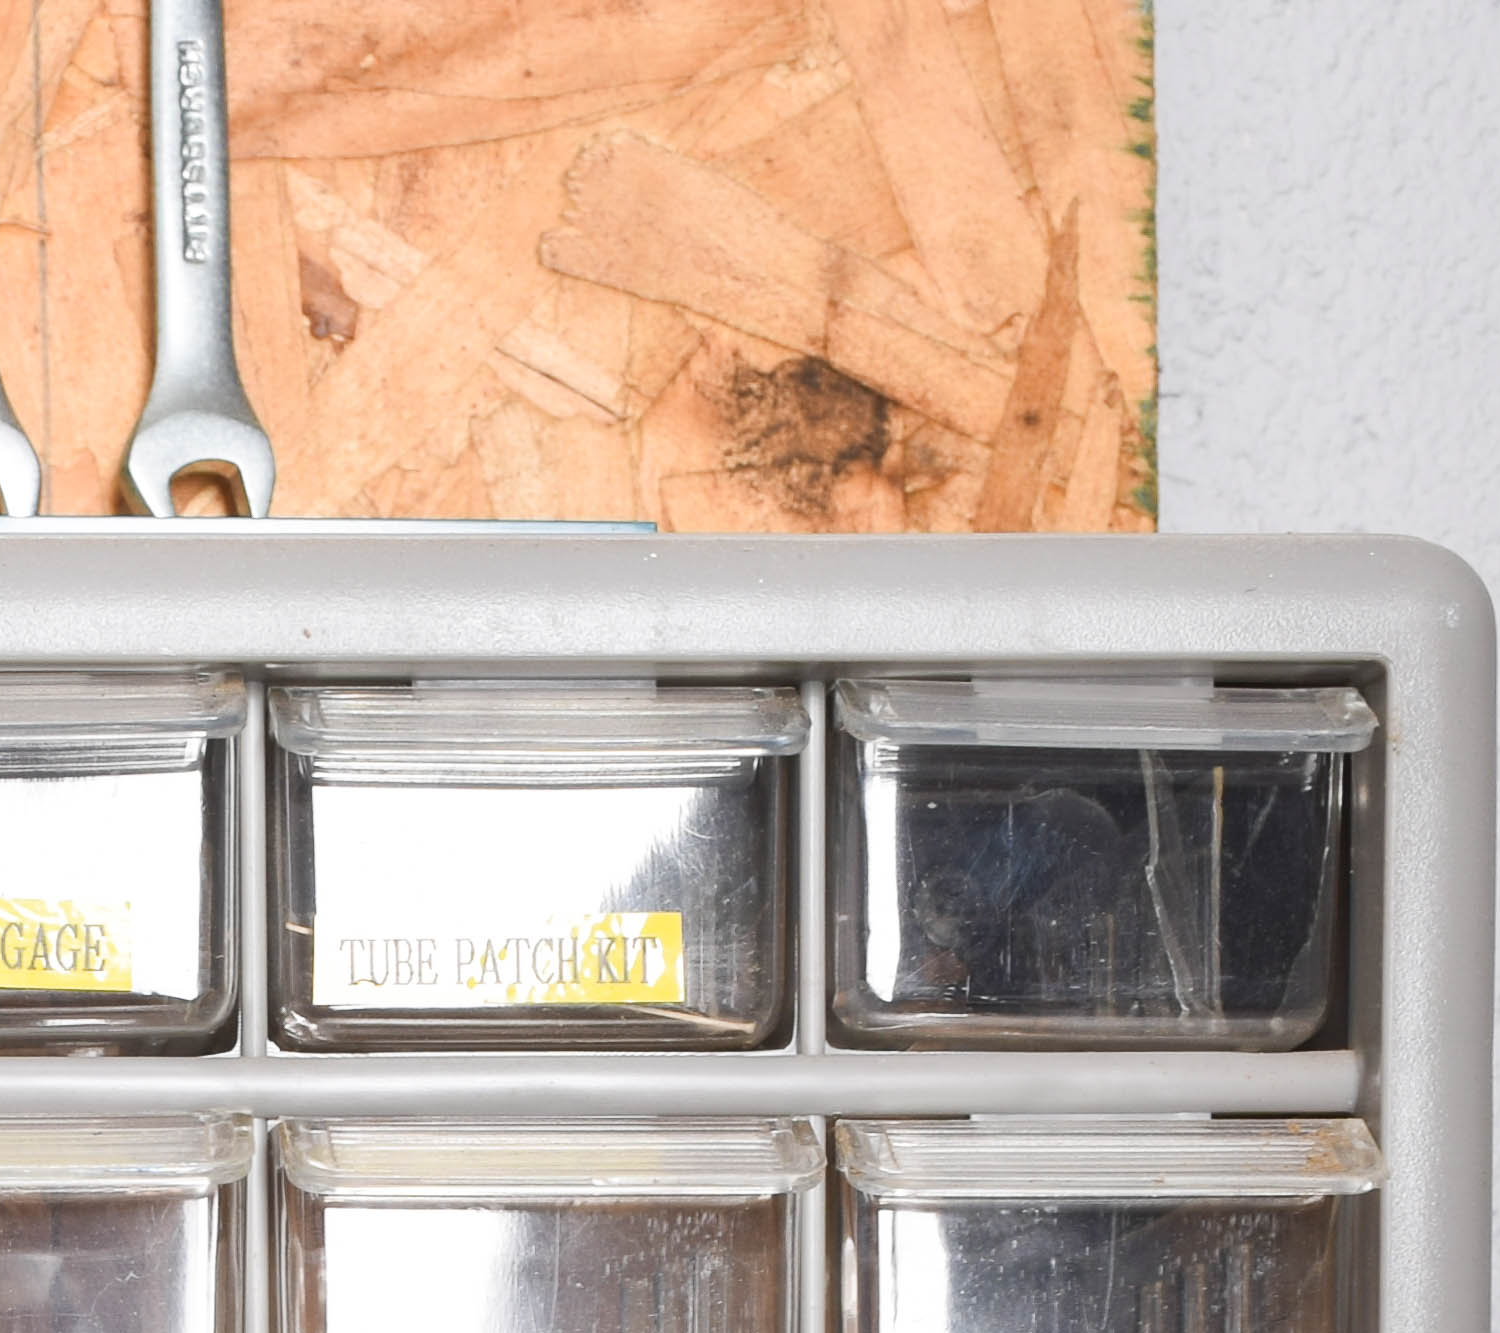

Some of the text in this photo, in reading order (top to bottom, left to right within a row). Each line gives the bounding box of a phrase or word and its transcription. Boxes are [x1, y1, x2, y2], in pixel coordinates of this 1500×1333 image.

[177, 40, 207, 264] PITTSBURGH
[1, 922, 106, 973] GAGE
[341, 937, 659, 985] TUBE PATCH KIT
